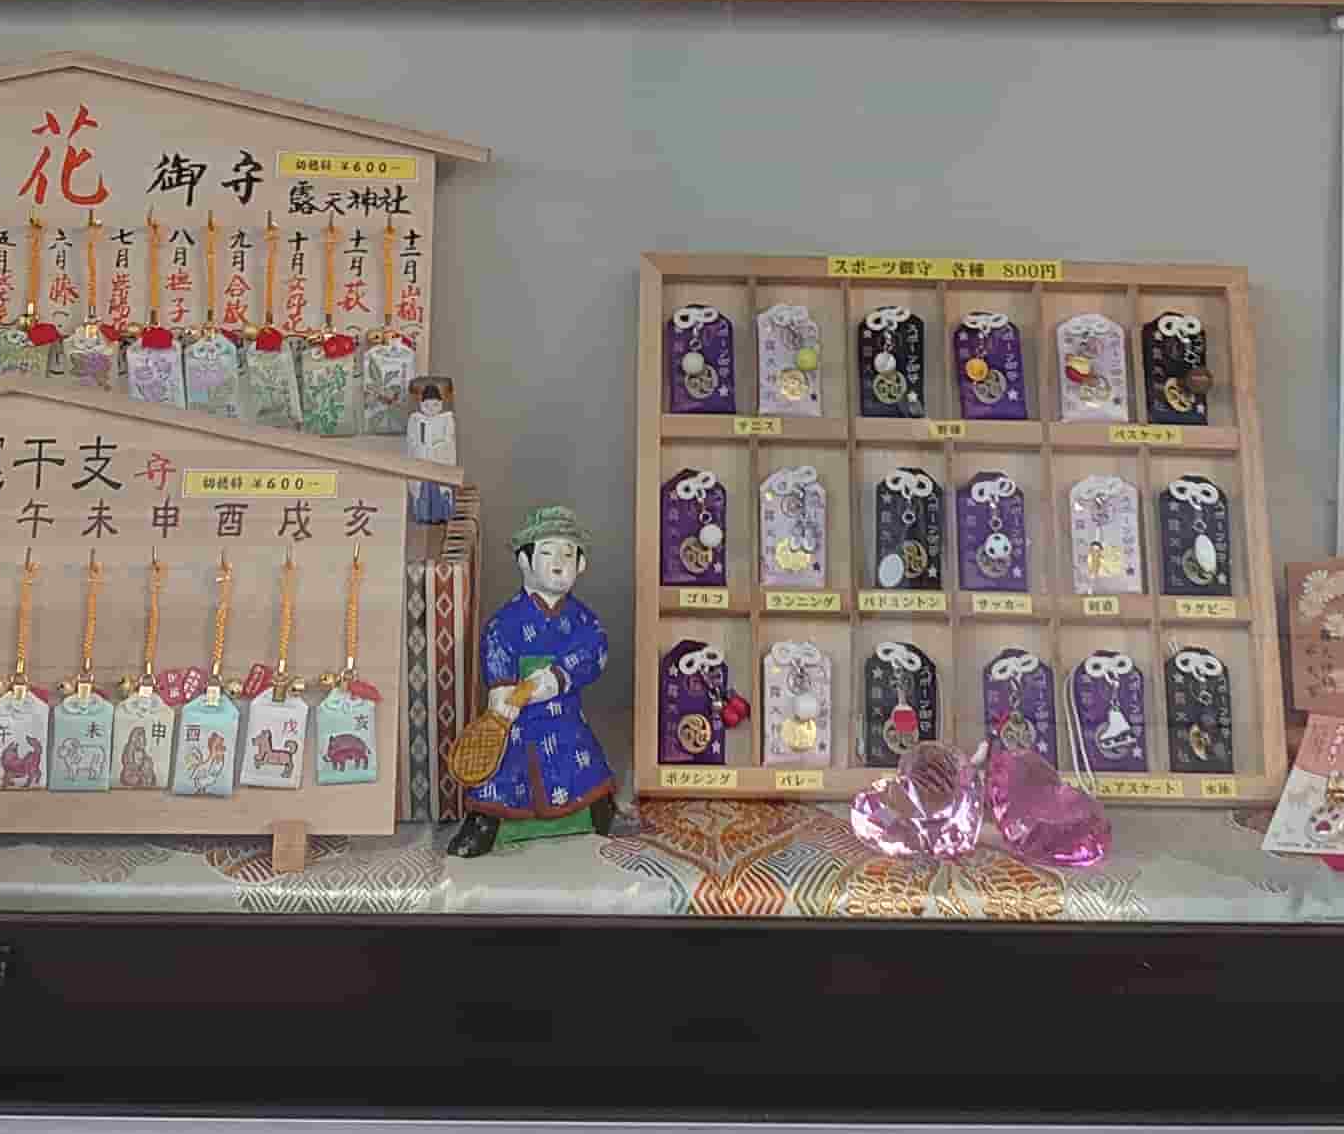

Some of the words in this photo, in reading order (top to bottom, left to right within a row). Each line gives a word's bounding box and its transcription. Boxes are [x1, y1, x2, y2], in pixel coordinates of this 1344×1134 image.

[18, 103, 113, 206] 花
[286, 180, 414, 216] 露天神社
[832, 257, 936, 278] スポーツ御守
[951, 260, 989, 280] 各種
[1002, 262, 1058, 282] 800円
[734, 418, 777, 434] テニス
[15, 499, 56, 539] 午
[85, 498, 120, 538] 未
[152, 497, 182, 540] 申
[214, 500, 250, 537] 酉
[341, 498, 381, 539] 亥
[684, 590, 727, 607] ゴルフ
[770, 593, 837, 610] ランニング
[862, 593, 943, 610] バドミントン
[975, 595, 1029, 612] サッカー
[1179, 599, 1234, 617] ラグビー
